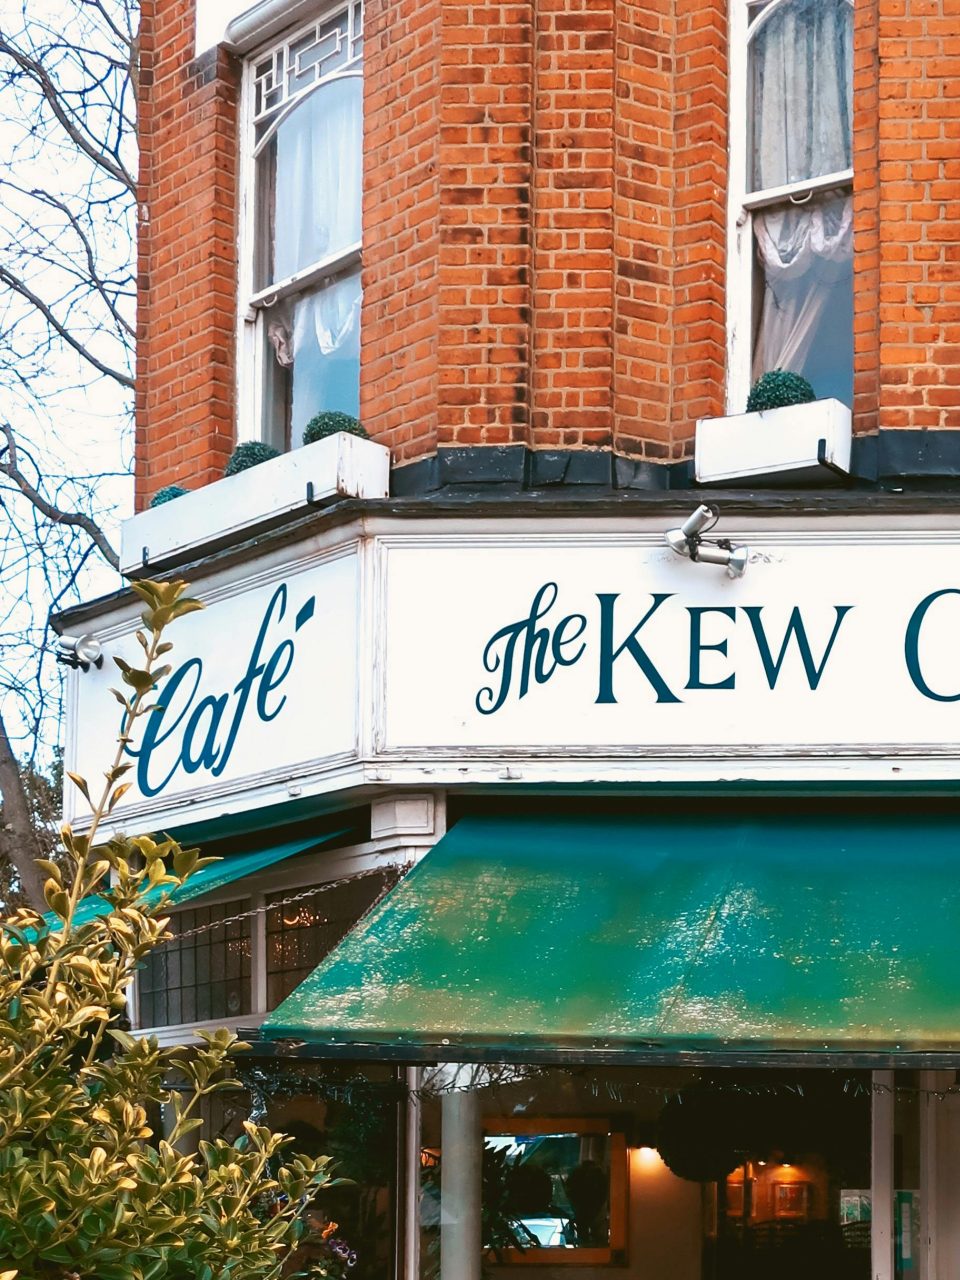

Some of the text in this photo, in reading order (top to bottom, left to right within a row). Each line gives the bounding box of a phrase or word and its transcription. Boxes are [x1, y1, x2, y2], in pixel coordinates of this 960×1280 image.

[121, 583, 316, 797] Café
[475, 581, 588, 715] The
[594, 593, 856, 704] KEW
